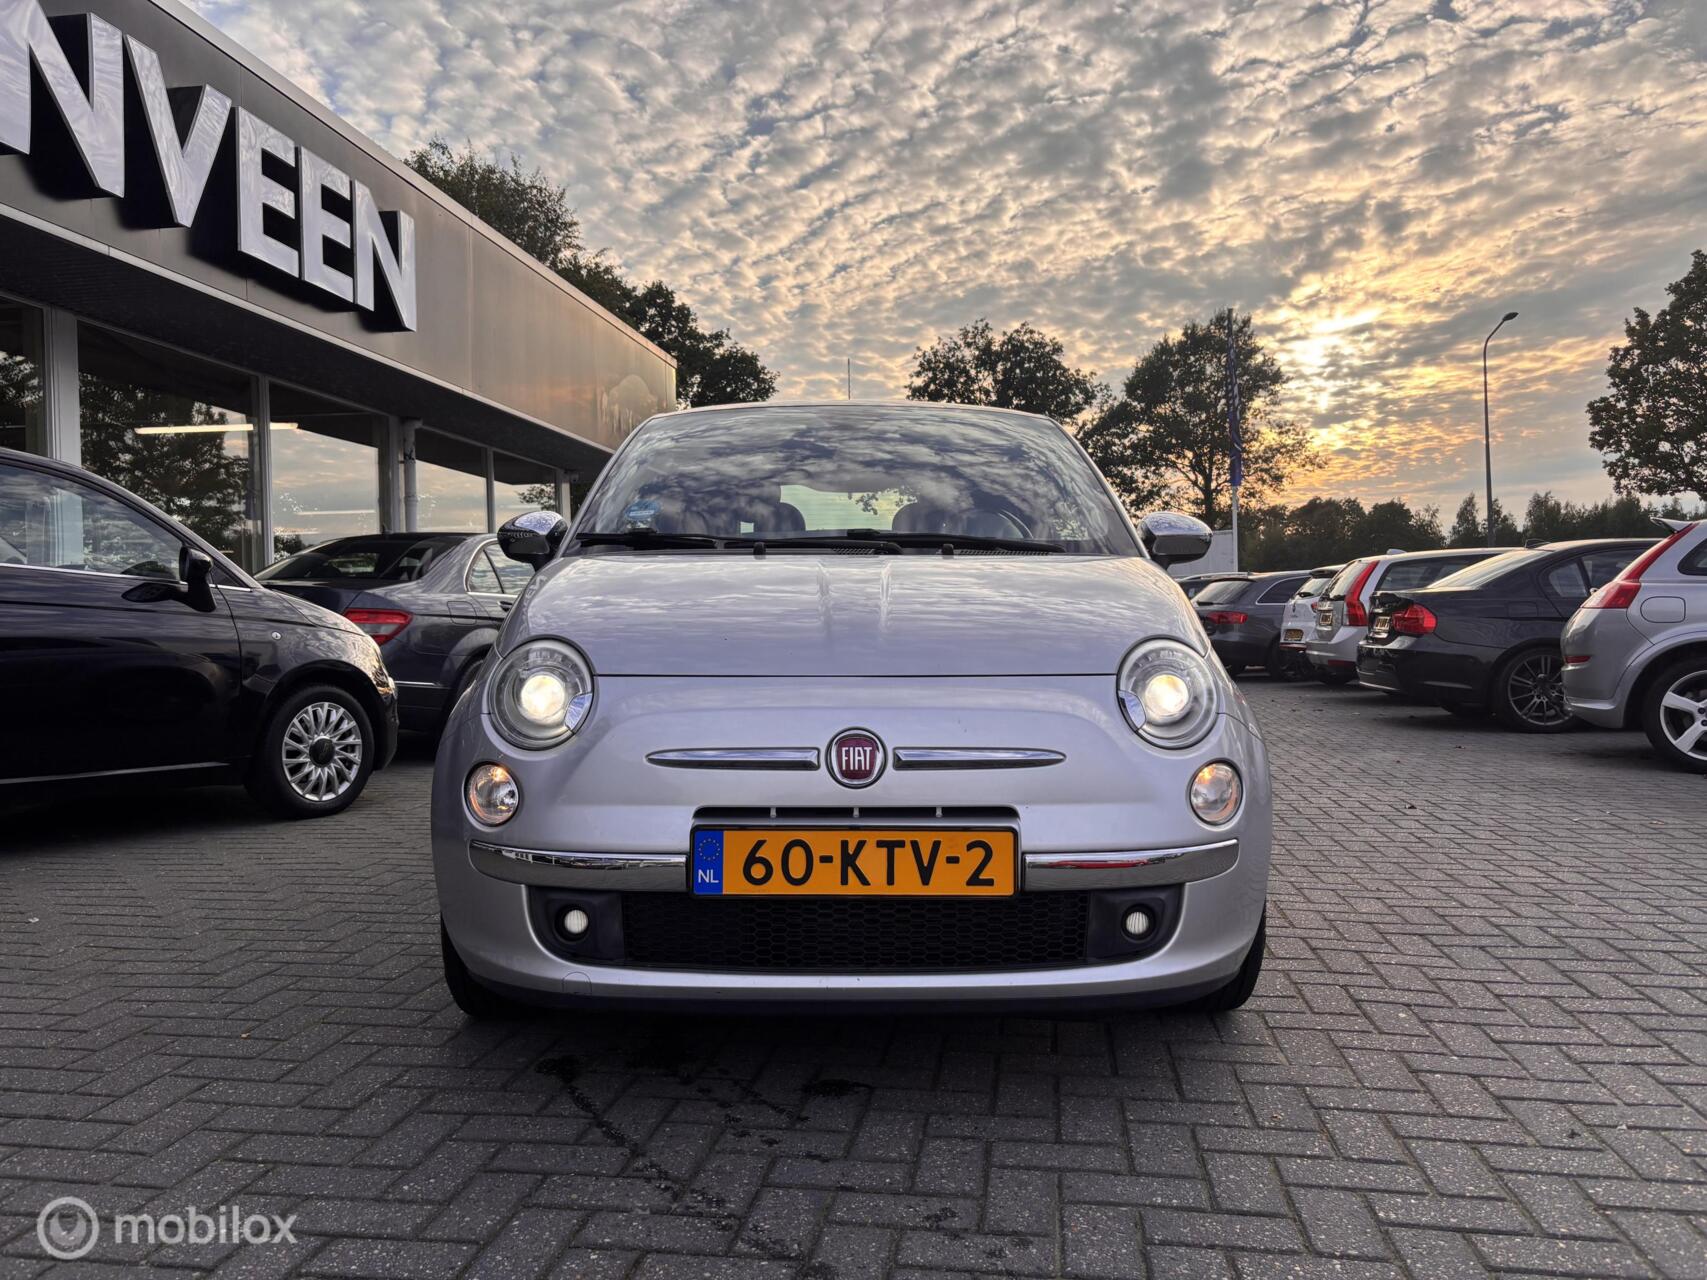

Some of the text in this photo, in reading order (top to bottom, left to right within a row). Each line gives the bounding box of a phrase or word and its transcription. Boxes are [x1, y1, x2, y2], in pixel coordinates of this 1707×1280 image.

[841, 746, 873, 771] FIAT
[742, 838, 995, 886] 60-KTV-2
[697, 869, 720, 884] NL
